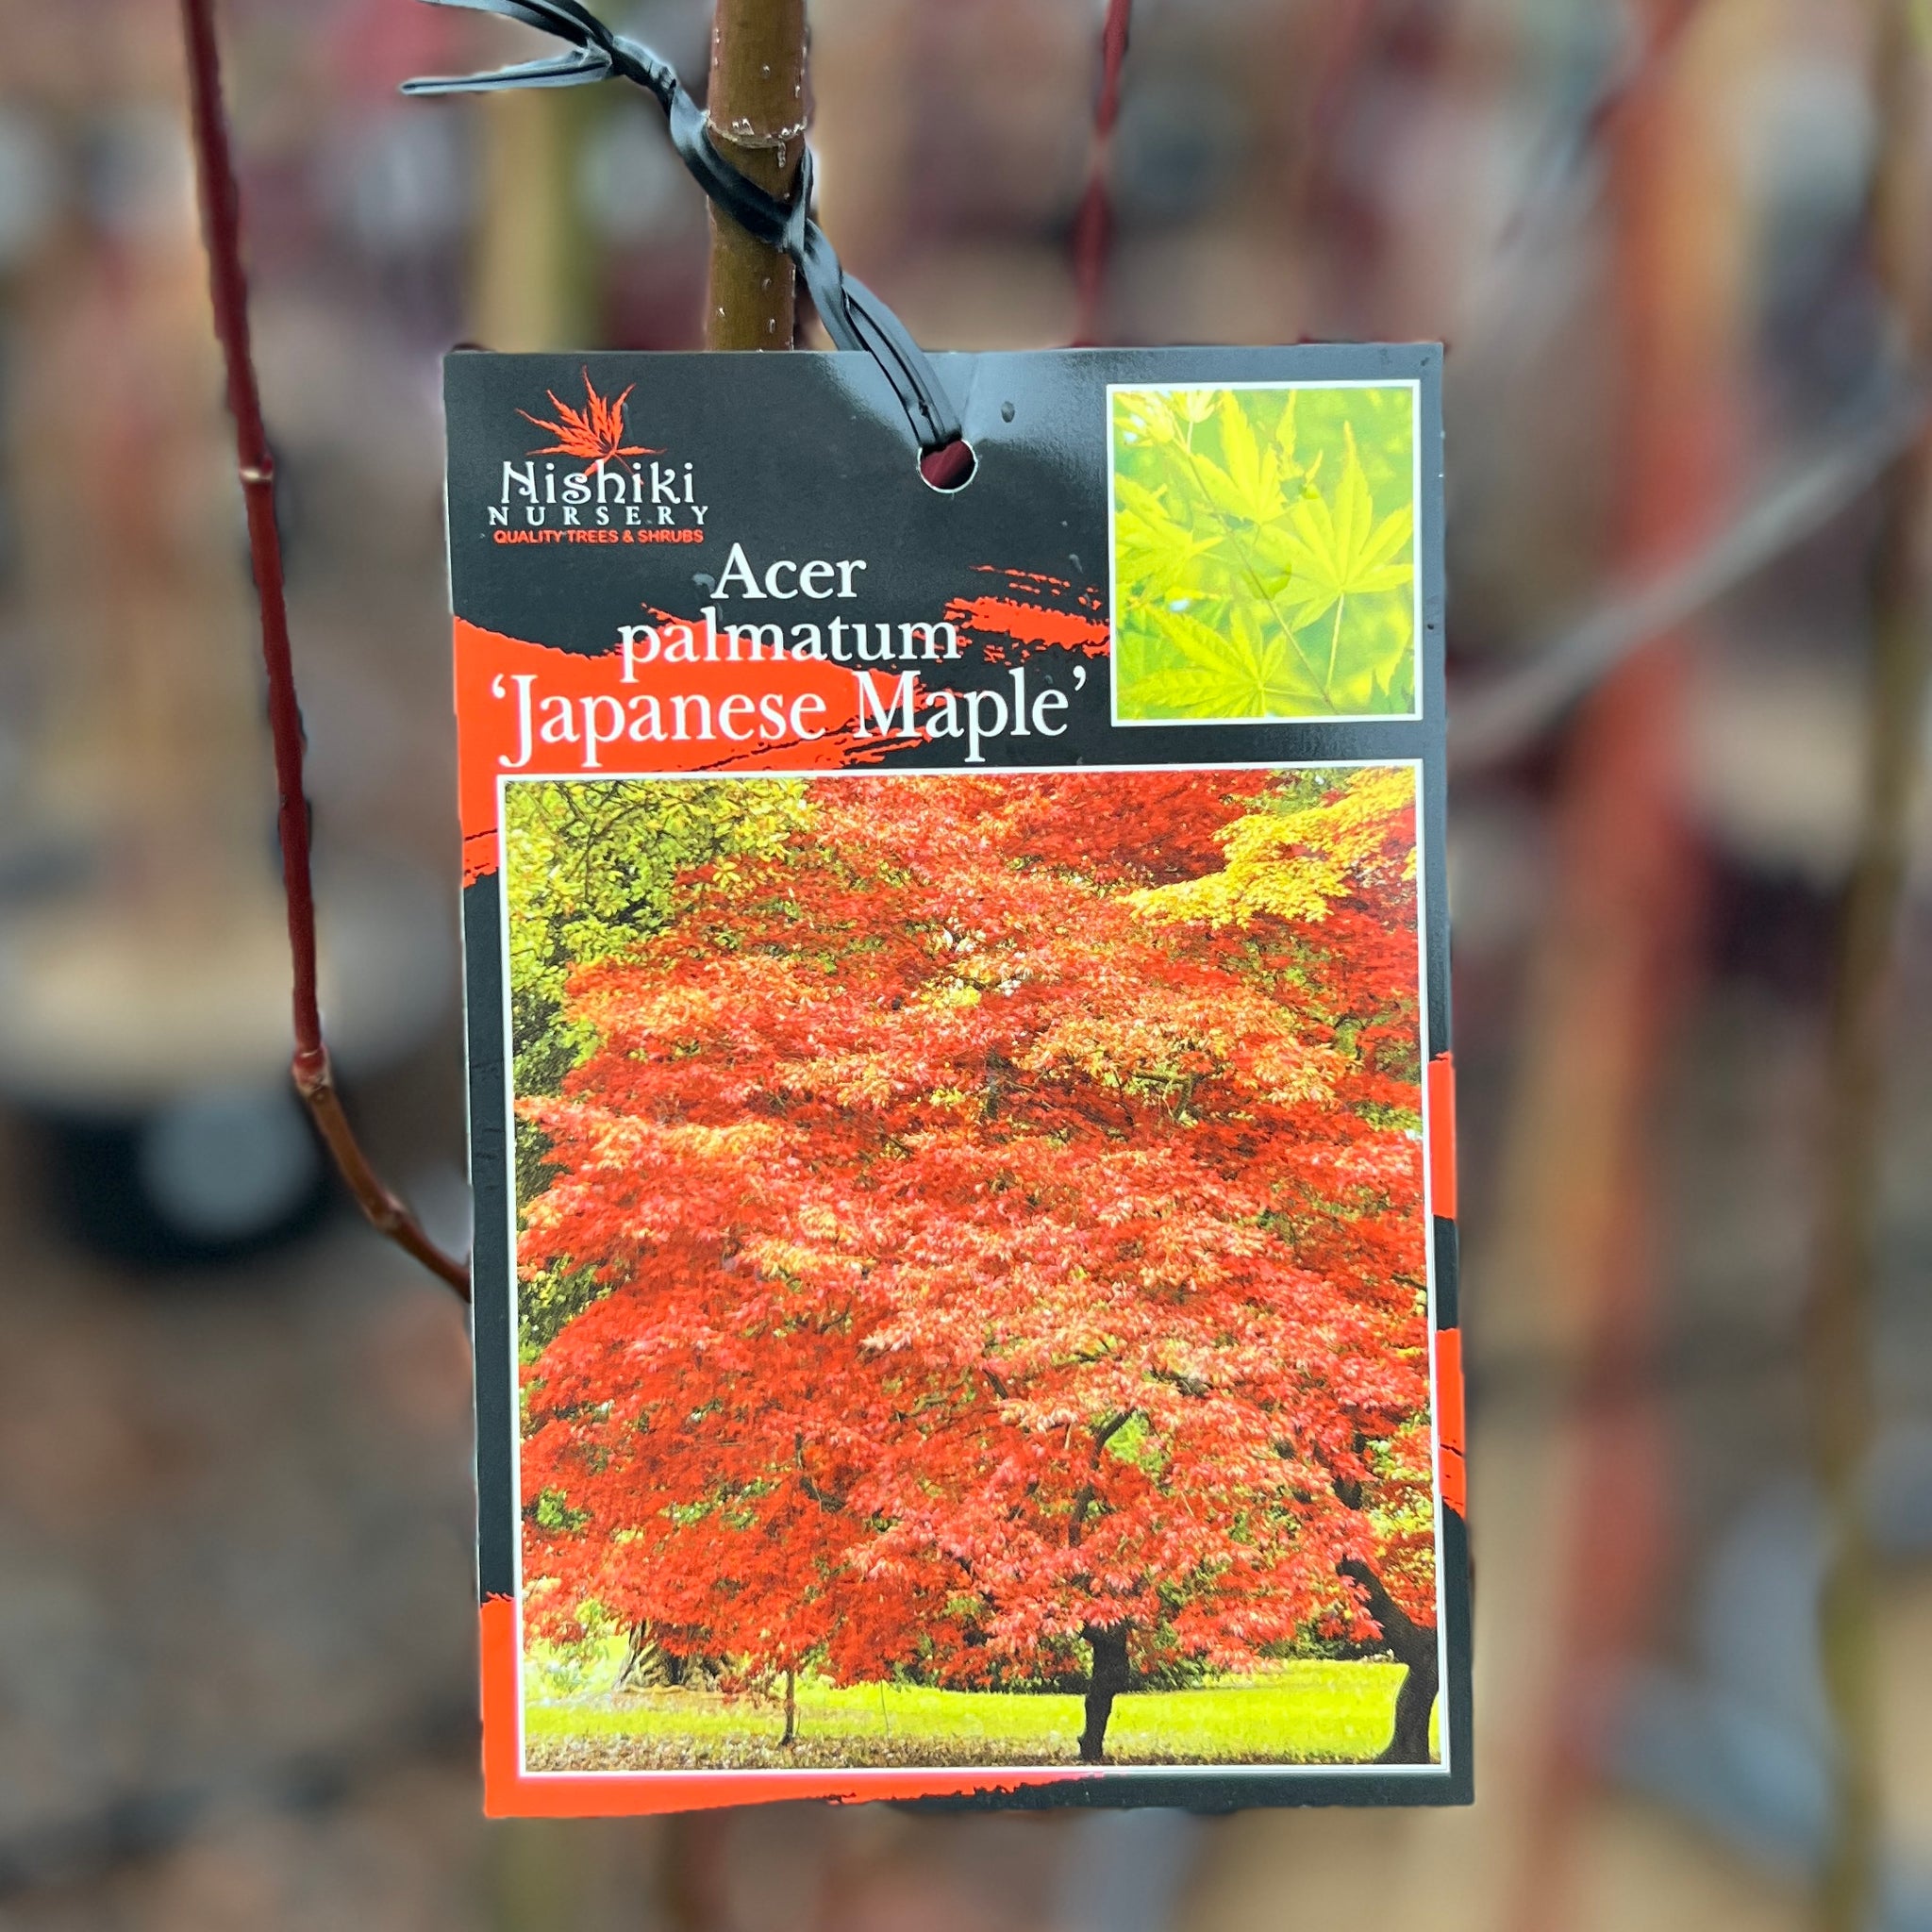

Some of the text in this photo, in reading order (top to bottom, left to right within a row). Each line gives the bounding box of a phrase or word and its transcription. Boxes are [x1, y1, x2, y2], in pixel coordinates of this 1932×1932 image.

[501, 458, 695, 504] Nishiki
[487, 505, 708, 525] NURSERY
[493, 528, 704, 544] QUALITY TREES & SHRUBS
[710, 542, 866, 600] Acer
[617, 608, 961, 682] palmatum
[491, 665, 1088, 768] ‘Japanese Maple’
